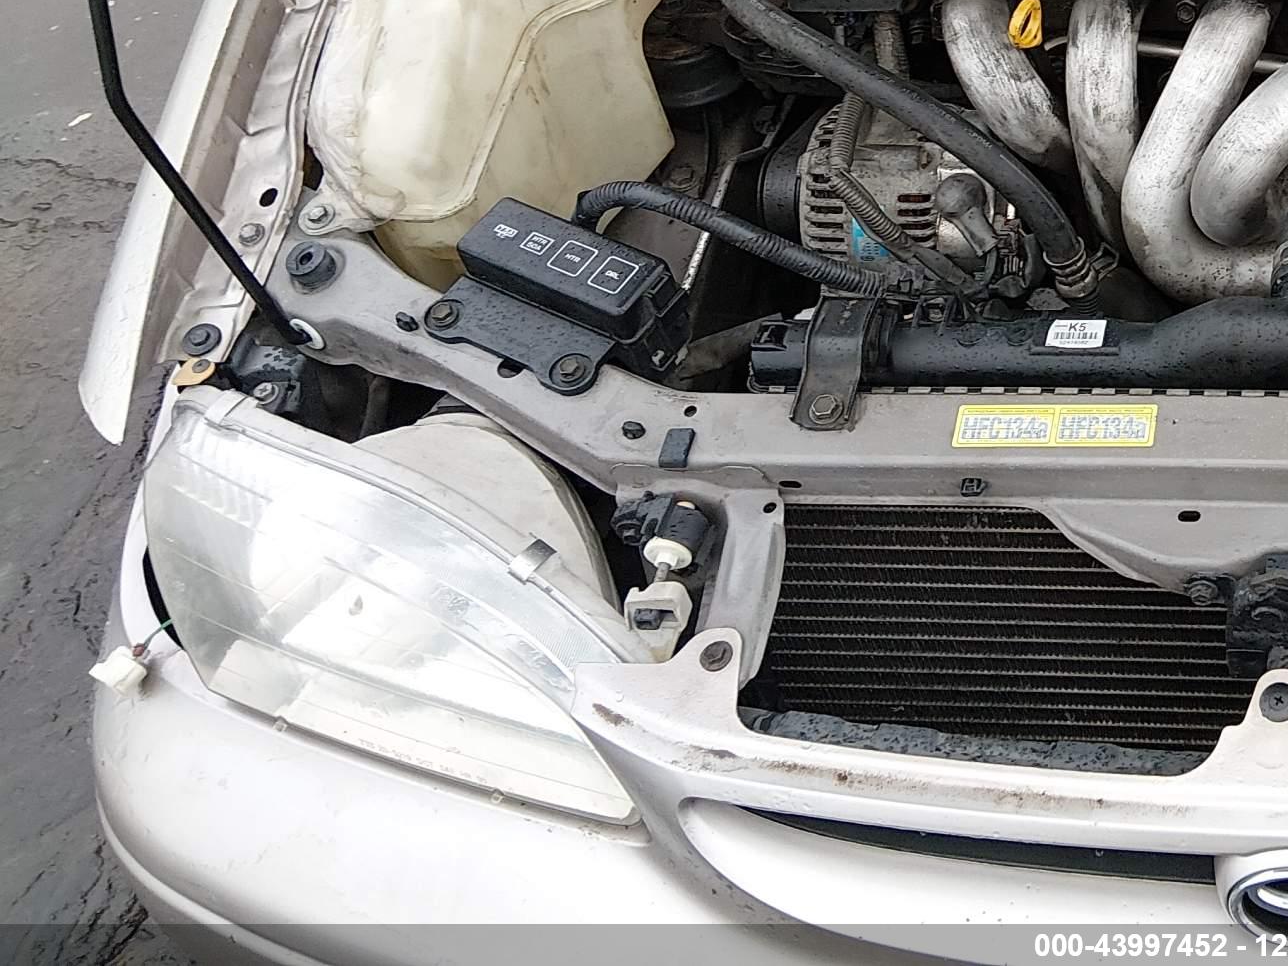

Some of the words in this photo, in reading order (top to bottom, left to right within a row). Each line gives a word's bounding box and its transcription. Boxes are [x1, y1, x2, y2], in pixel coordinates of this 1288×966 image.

[564, 253, 581, 263] HTR
[961, 417, 1049, 440] HFC134a
[1058, 416, 1148, 440] HFC134a
